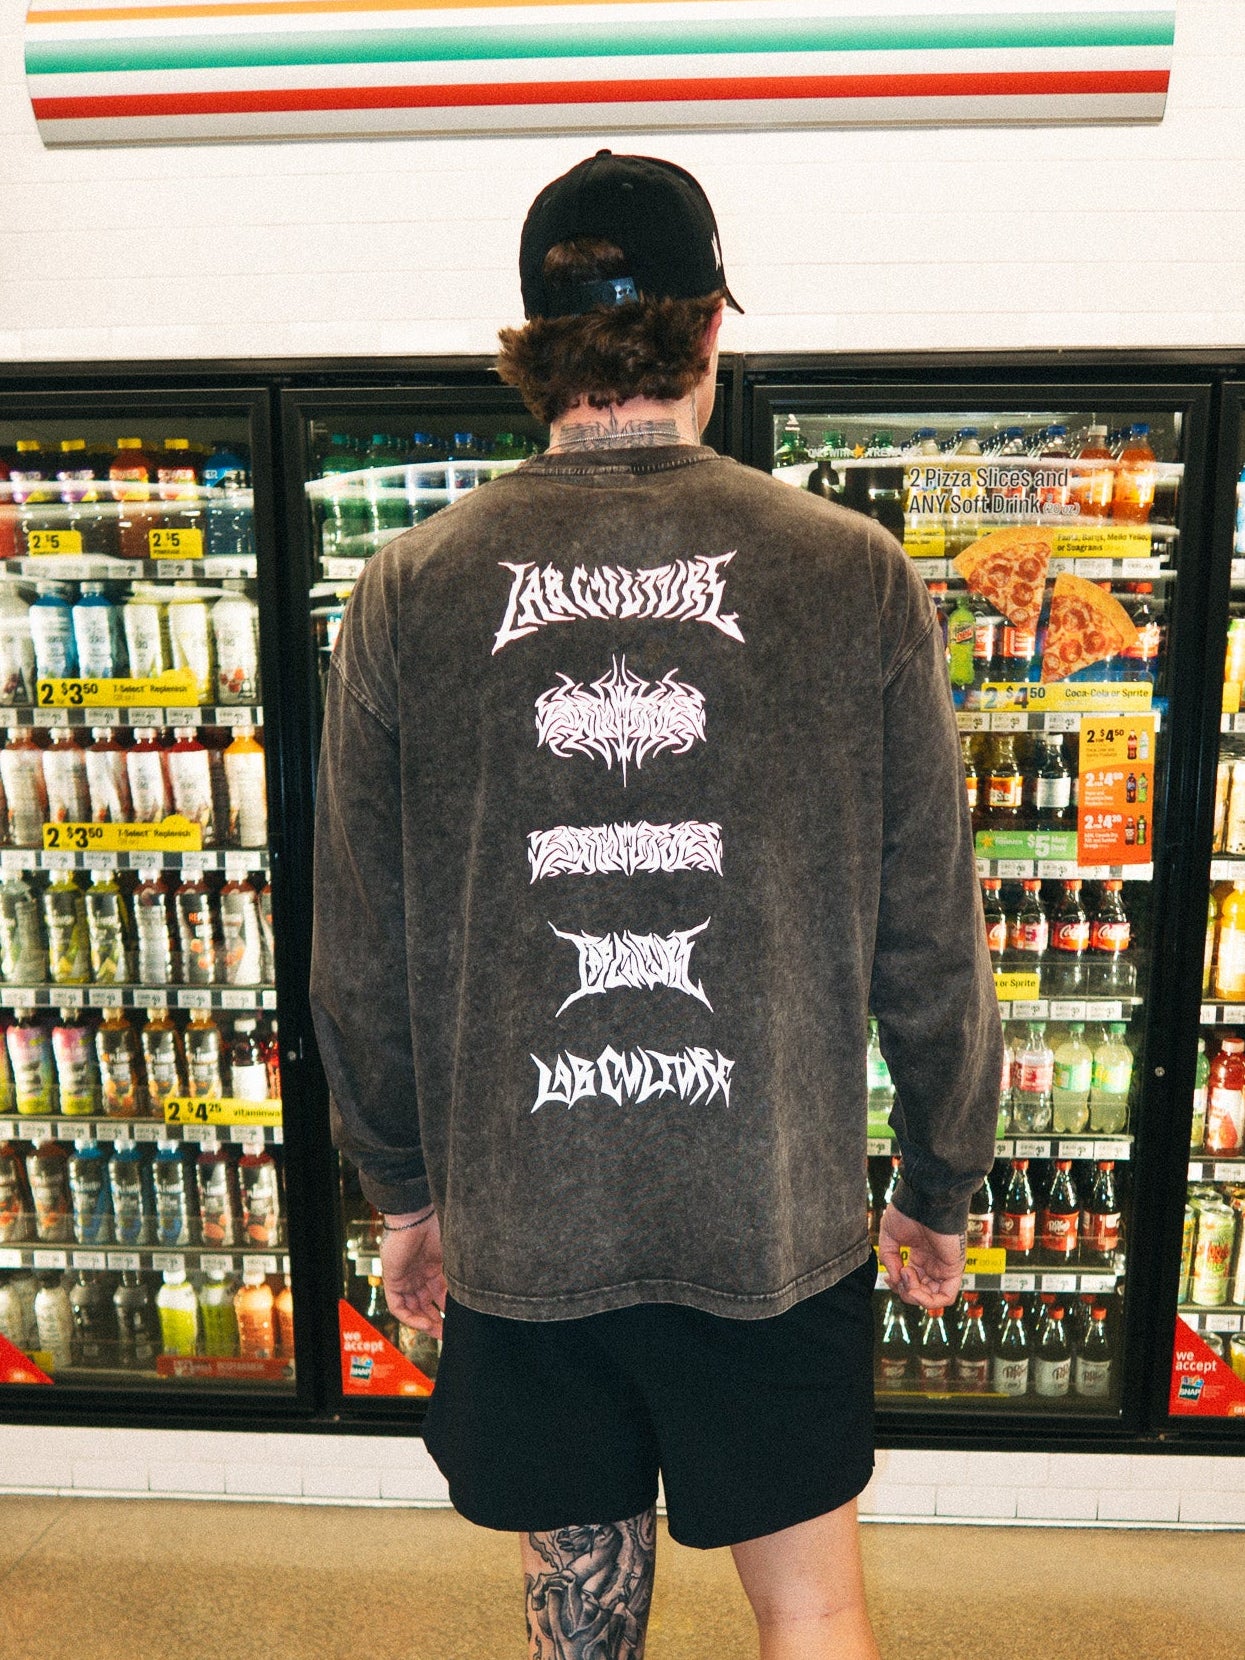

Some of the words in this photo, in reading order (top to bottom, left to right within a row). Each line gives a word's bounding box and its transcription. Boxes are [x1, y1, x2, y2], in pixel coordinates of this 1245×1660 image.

[909, 468, 920, 487] 2
[926, 468, 971, 487] Pizza
[976, 467, 1031, 487] Slices
[1035, 468, 1069, 487] and
[908, 495, 946, 514] ANY
[950, 494, 987, 514] Soft
[993, 494, 1040, 514] Drink
[32, 535, 41, 549] 2
[152, 532, 161, 547] 2
[40, 683, 54, 704] 2
[984, 688, 998, 709] 2
[1122, 689, 1149, 699] Sprite
[1087, 729, 1095, 743] 2
[1085, 772, 1095, 787] 2
[1084, 814, 1094, 829] 2
[46, 827, 60, 848] 2
[1010, 979, 1036, 988] Sprite
[530, 1050, 597, 1113] LAB
[597, 1044, 735, 1108] CULTURE
[168, 1102, 180, 1121] 2
[343, 1332, 361, 1341] we
[343, 1341, 384, 1354] accept
[1176, 1351, 1195, 1361] we
[1175, 1360, 1217, 1374] accept
